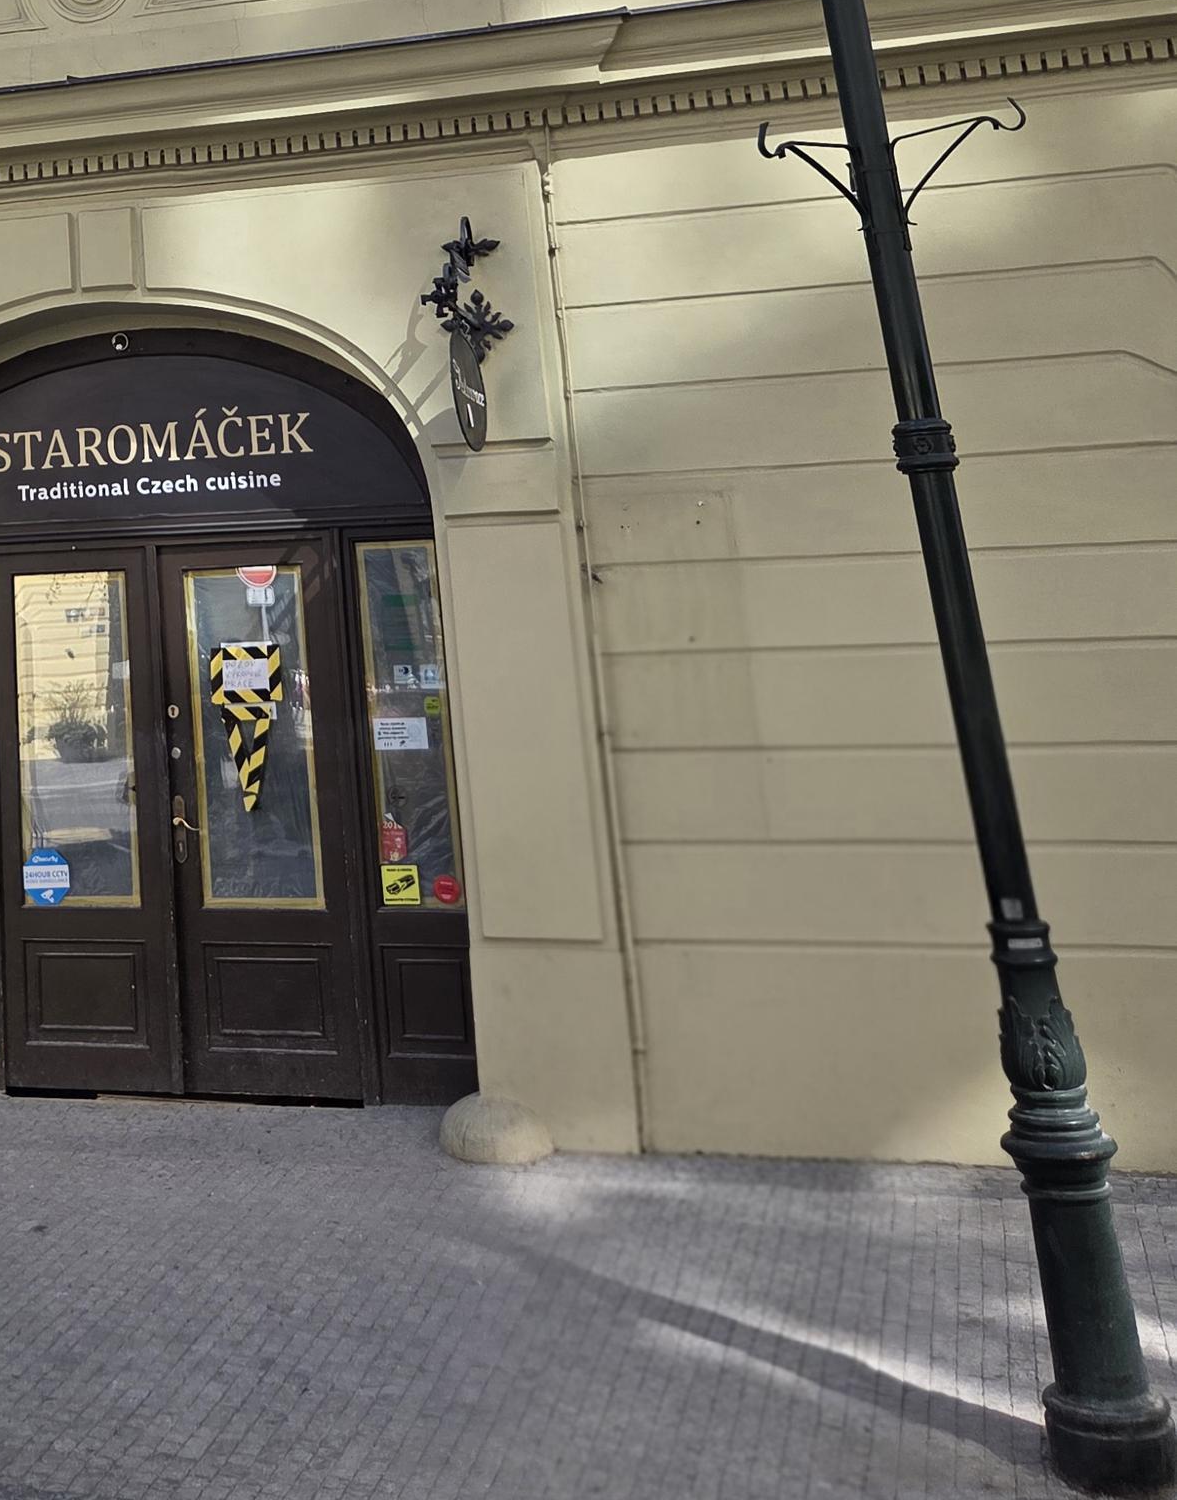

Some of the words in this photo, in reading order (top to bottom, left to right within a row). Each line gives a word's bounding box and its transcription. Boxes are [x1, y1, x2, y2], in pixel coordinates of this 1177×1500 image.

[17, 478, 130, 502] Traditional
[136, 474, 199, 494] Czech
[206, 470, 282, 490] cuisine
[52, 870, 68, 878] CCTV
